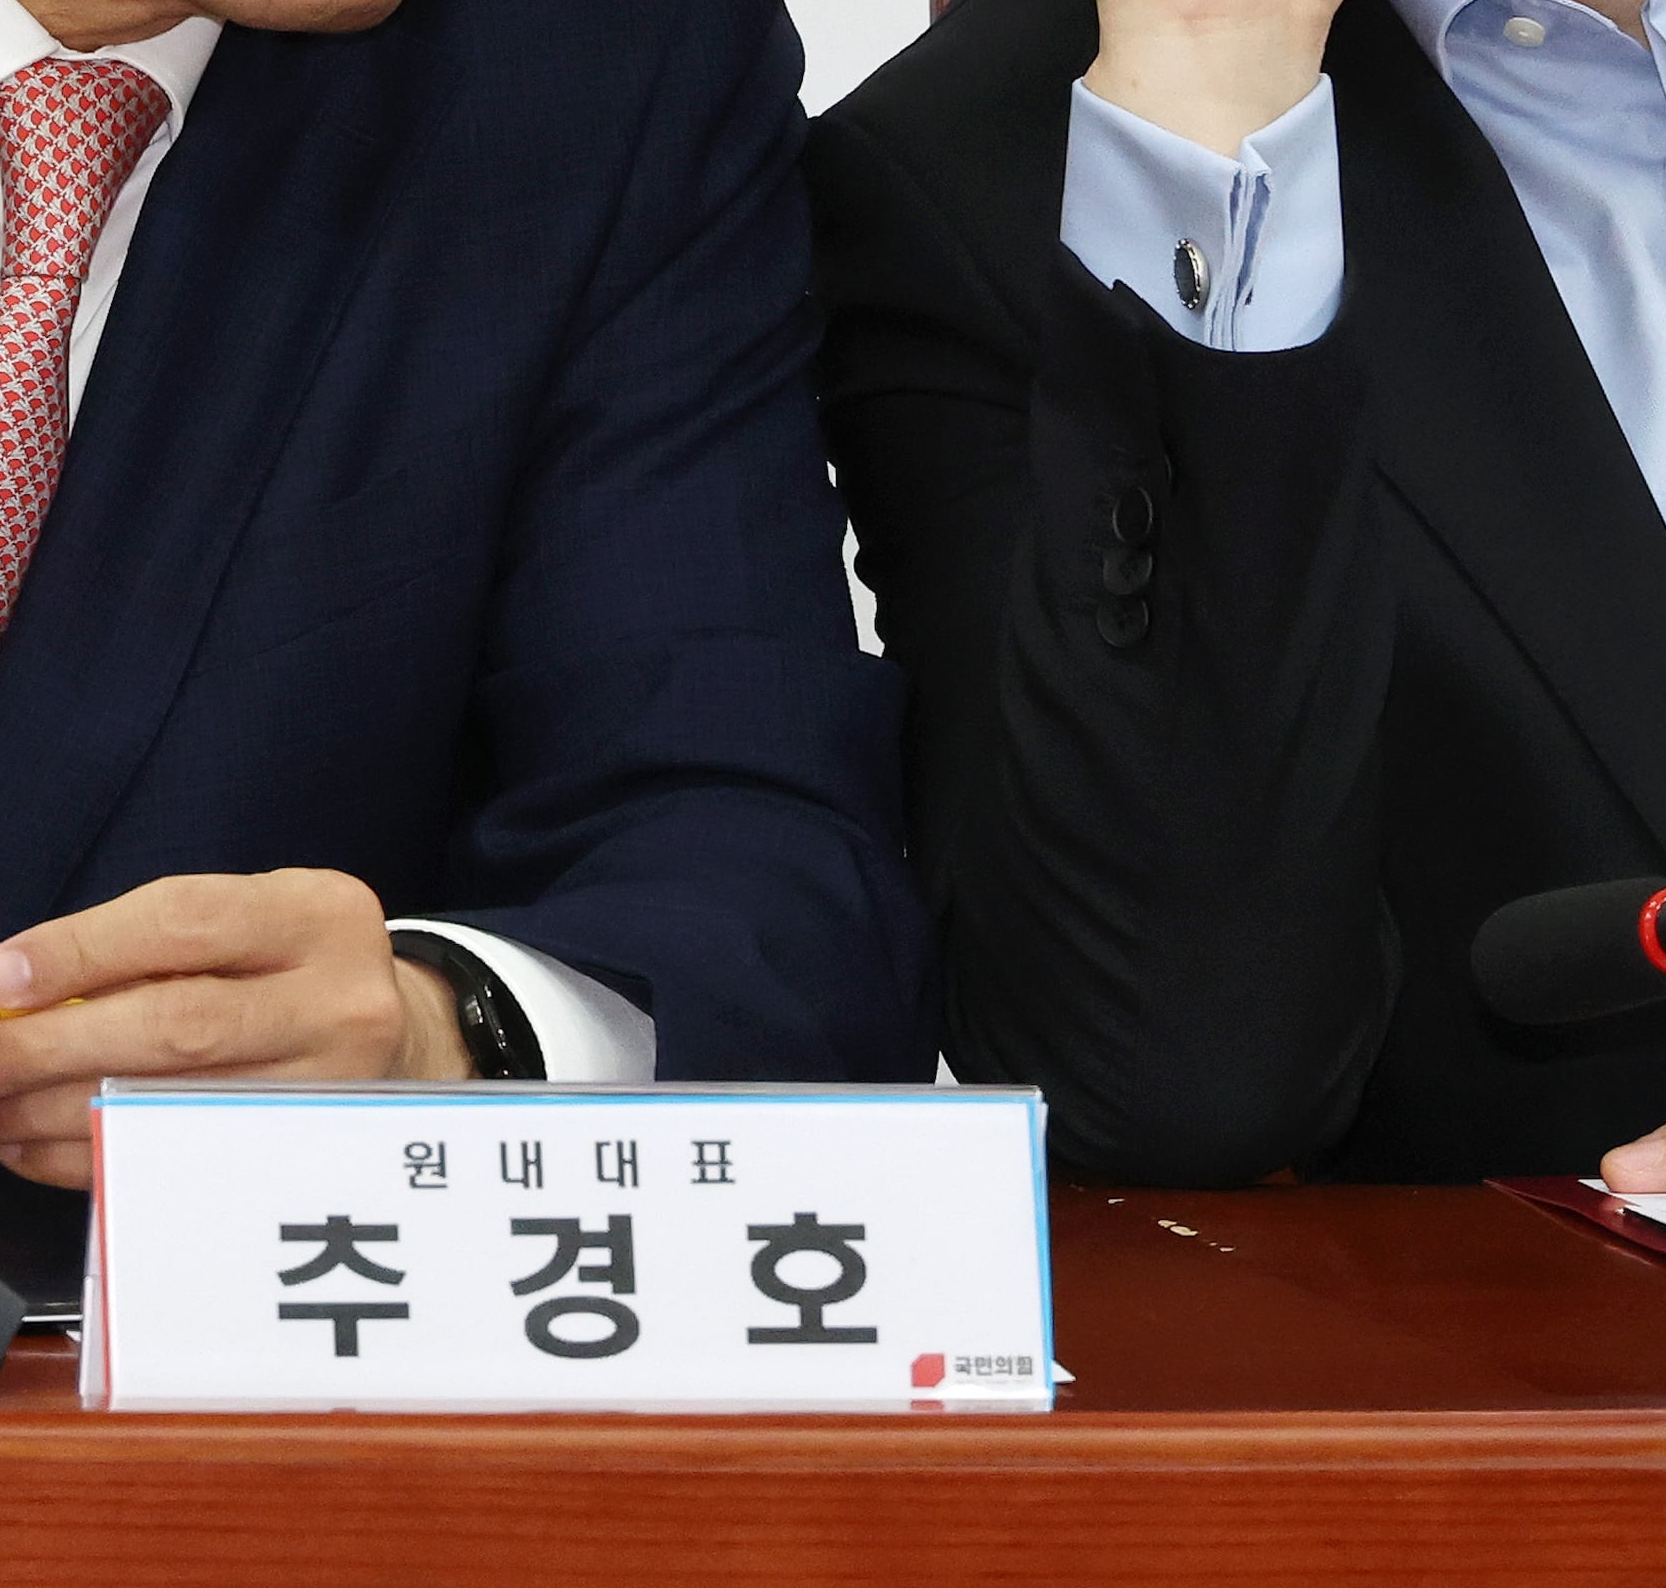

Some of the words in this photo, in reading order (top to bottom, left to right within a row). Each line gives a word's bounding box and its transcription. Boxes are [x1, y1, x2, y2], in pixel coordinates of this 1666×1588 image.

[404, 1140, 734, 1189] 원내대표
[277, 1212, 878, 1360] 추경호
[954, 1355, 1034, 1376] 국민의힘
